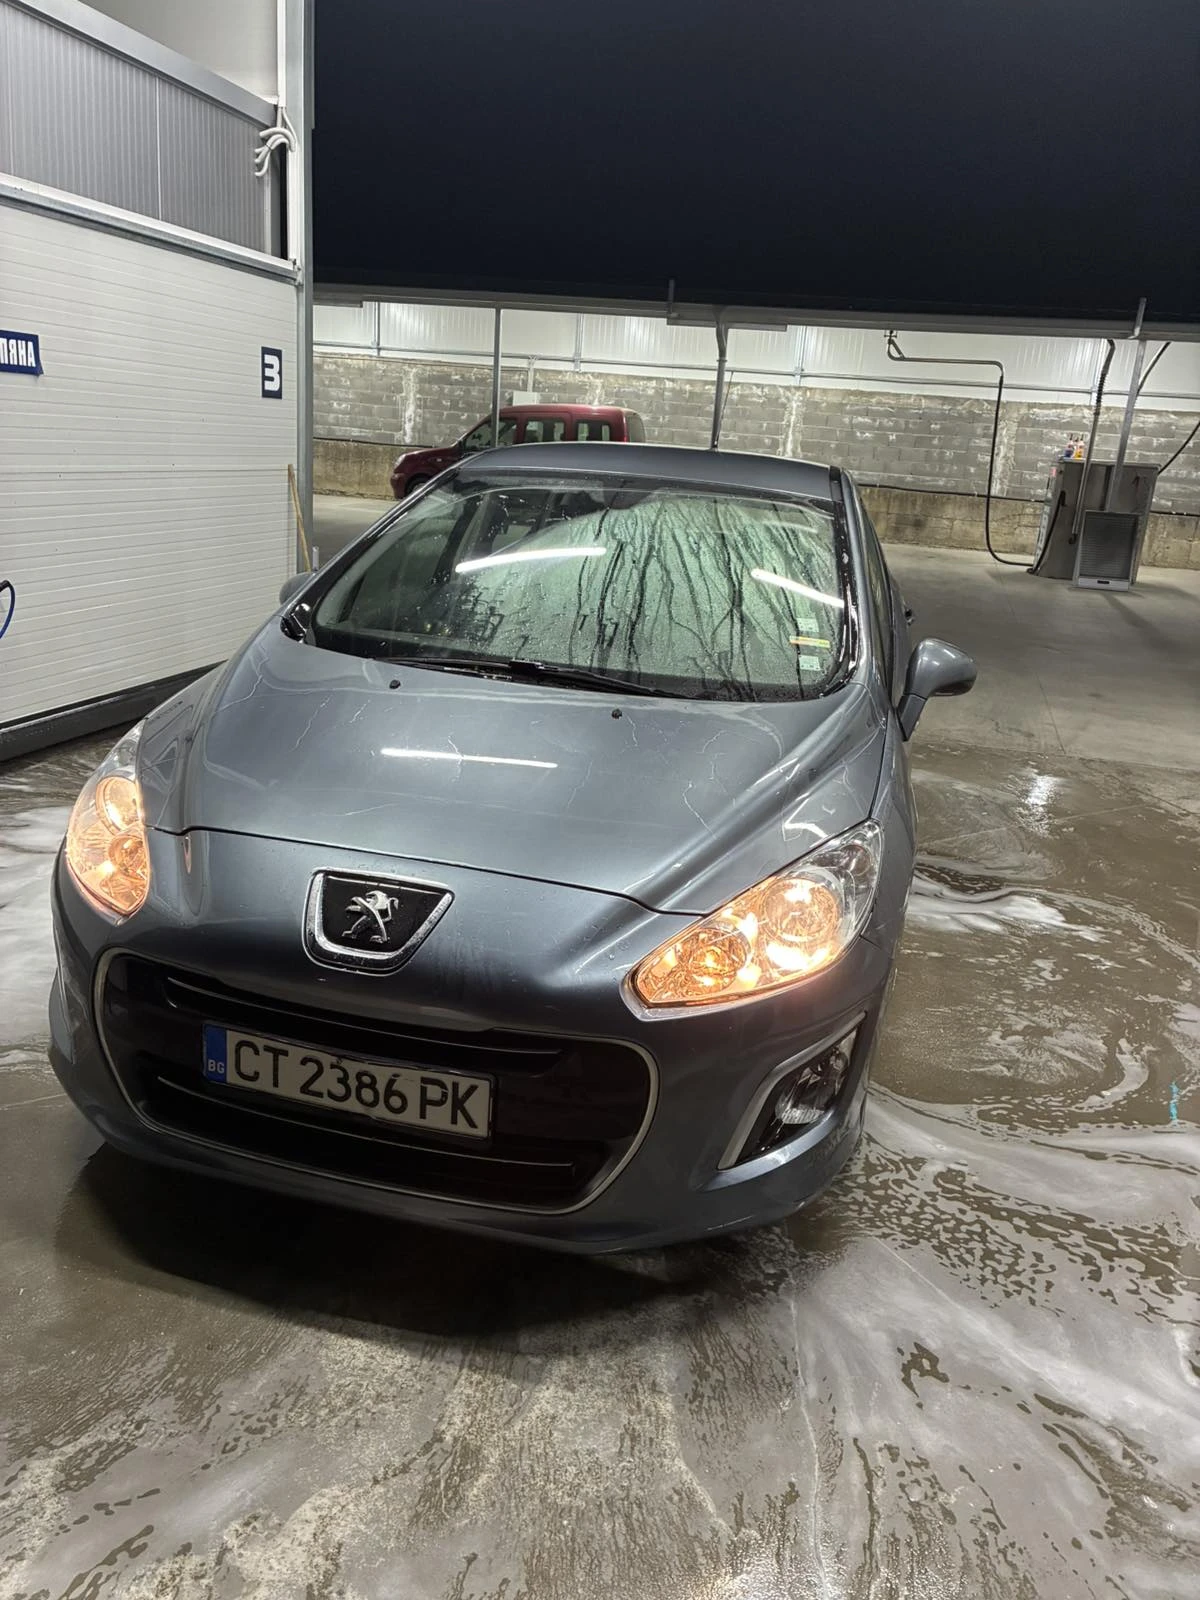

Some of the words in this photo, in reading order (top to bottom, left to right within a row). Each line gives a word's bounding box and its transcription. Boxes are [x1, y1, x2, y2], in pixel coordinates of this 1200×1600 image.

[264, 354, 280, 391] 3
[207, 1059, 225, 1074] BG
[234, 1040, 289, 1088] CT
[299, 1056, 408, 1115] 2386
[419, 1076, 478, 1129] PK
